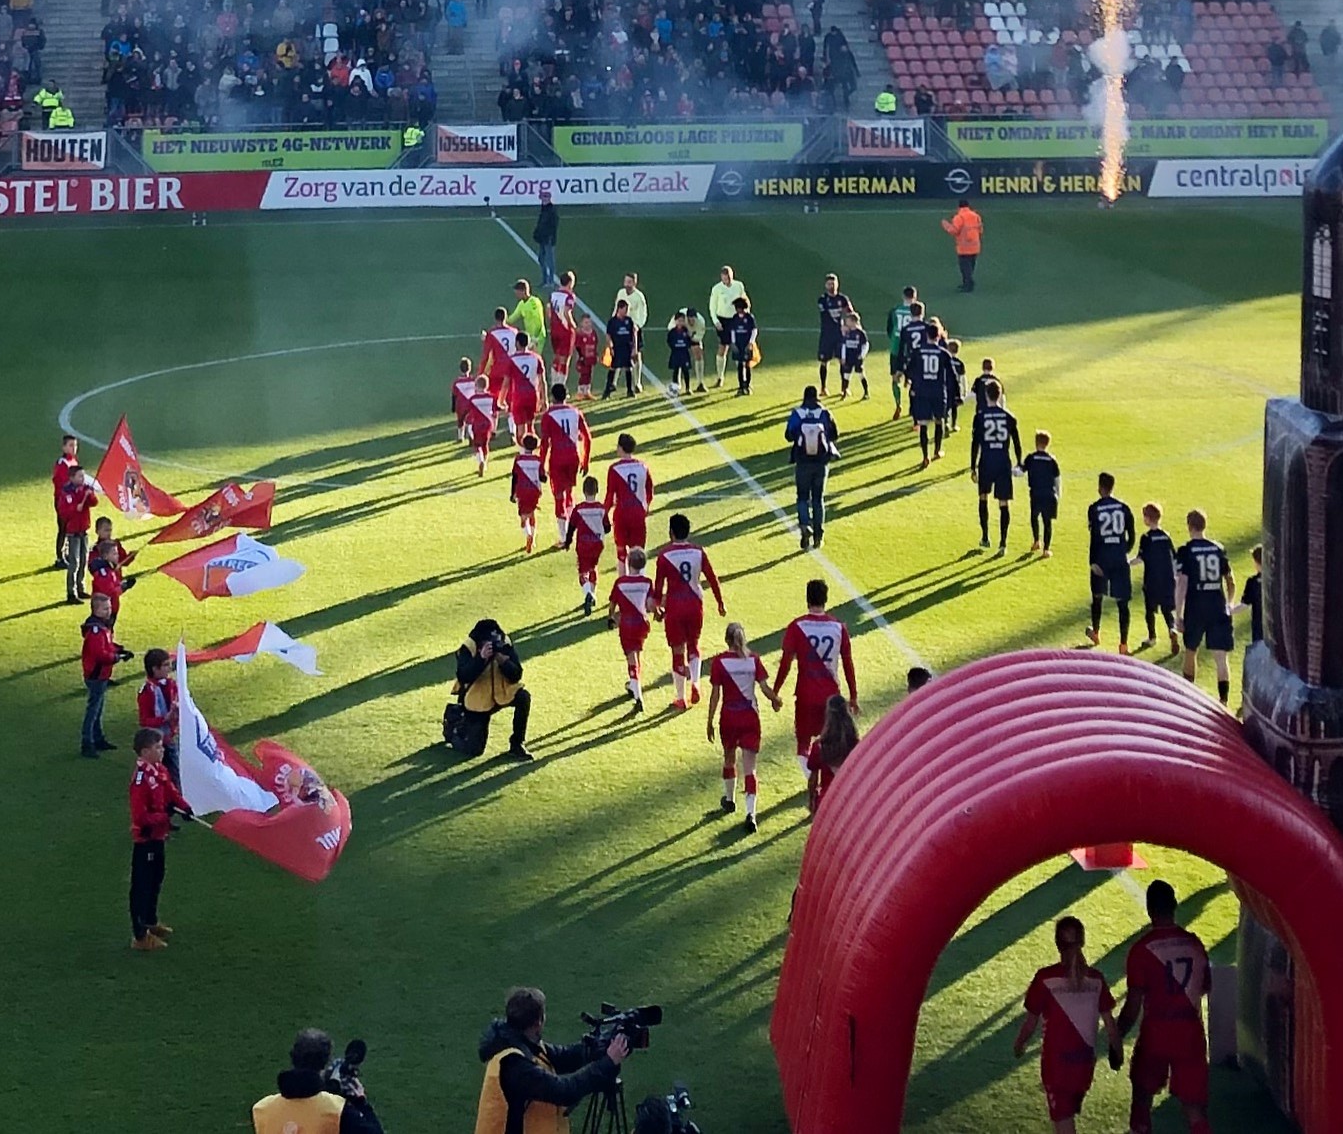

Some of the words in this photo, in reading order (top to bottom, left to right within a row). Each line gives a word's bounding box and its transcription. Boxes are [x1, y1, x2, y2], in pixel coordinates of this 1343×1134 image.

[571, 130, 675, 146] GENADELOOS
[678, 130, 719, 145] LAGE
[721, 129, 785, 143] PRIJZEN
[848, 127, 923, 148] VLEUTEN
[956, 127, 996, 141] NIET
[998, 126, 1052, 140] OMDAT
[1056, 126, 1087, 140] HET
[1189, 124, 1243, 138] OMDAT
[1246, 124, 1278, 138] HET
[1282, 124, 1320, 138] KAN.
[25, 138, 103, 164] HOUTEN
[152, 140, 188, 155] HET
[190, 138, 278, 154] NIEUWSTE
[281, 135, 393, 153] 4G-NETWERK
[440, 134, 515, 153] IJSSELSTEIN
[90, 177, 185, 211] BIER
[283, 177, 338, 203] Zorg
[341, 178, 384, 197] van
[389, 175, 417, 196] de
[419, 175, 477, 196] Zaak
[499, 175, 552, 197] Zorg
[555, 177, 598, 195] van
[602, 173, 630, 194] de
[632, 171, 689, 194] Zaak
[753, 177, 811, 196] HENRI
[816, 177, 830, 194] &
[833, 176, 916, 194] HERMAN
[981, 176, 1038, 194] HENRI
[1043, 176, 1056, 194] &
[911, 332, 922, 349] 2
[921, 355, 939, 374] 10
[983, 419, 1008, 442] 25
[627, 473, 638, 493] 6
[1098, 509, 1126, 537] 20
[679, 560, 692, 583] 8
[1195, 554, 1221, 582] 19
[1165, 957, 1194, 994] 17
